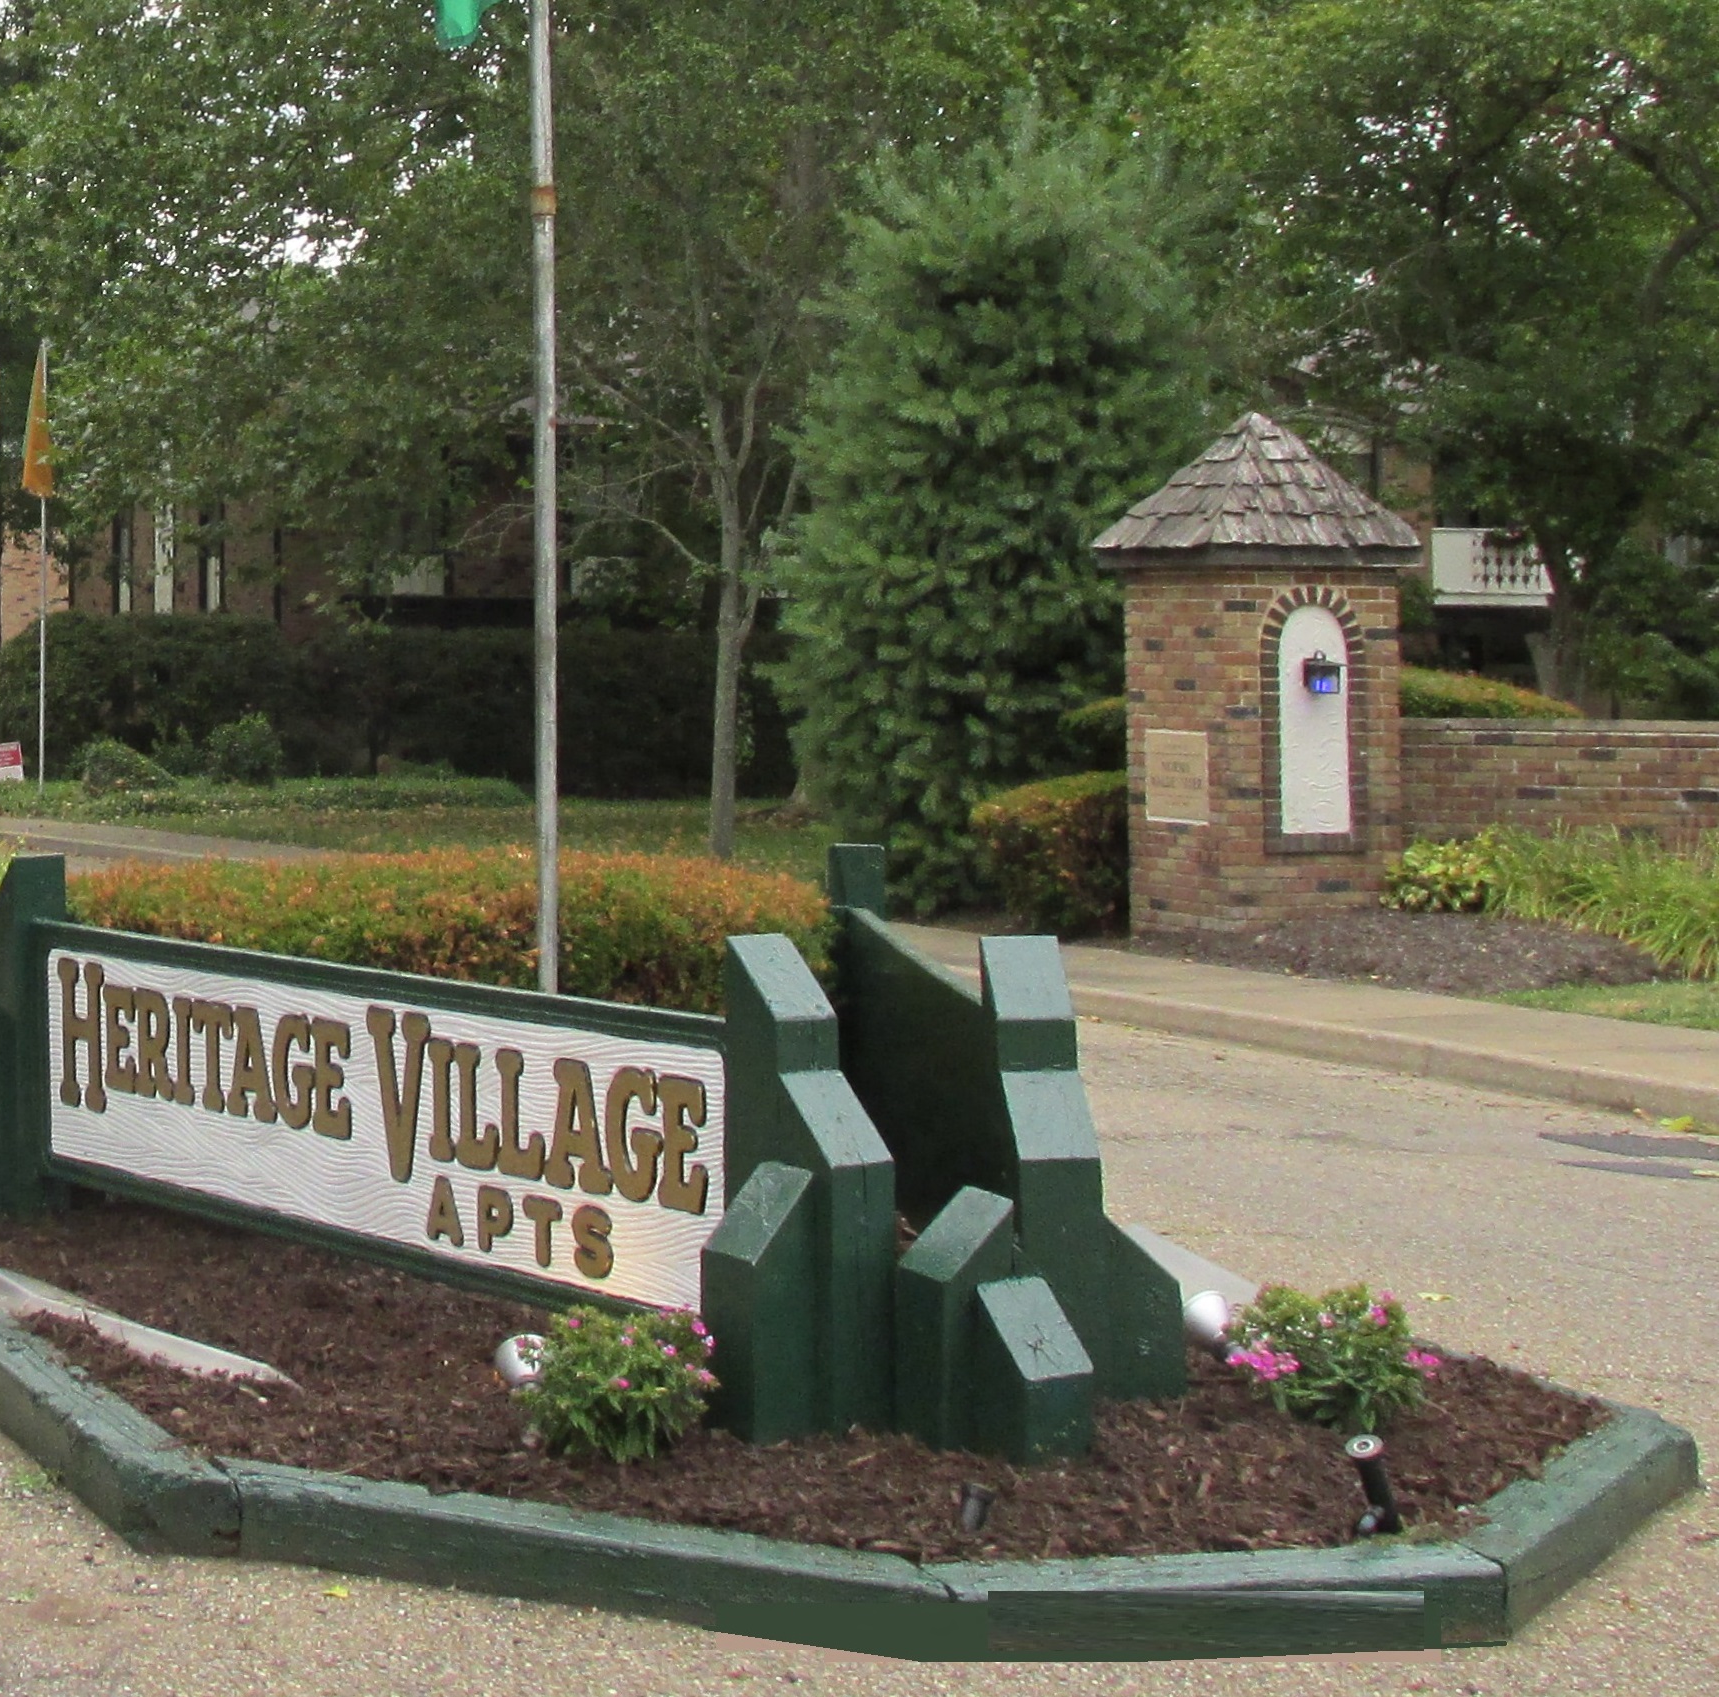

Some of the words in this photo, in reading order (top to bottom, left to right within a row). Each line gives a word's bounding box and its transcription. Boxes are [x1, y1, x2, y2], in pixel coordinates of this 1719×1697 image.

[56, 957, 353, 1141] HERITAGE
[366, 1004, 707, 1216] VILLAGE
[425, 1175, 615, 1279] APTS
